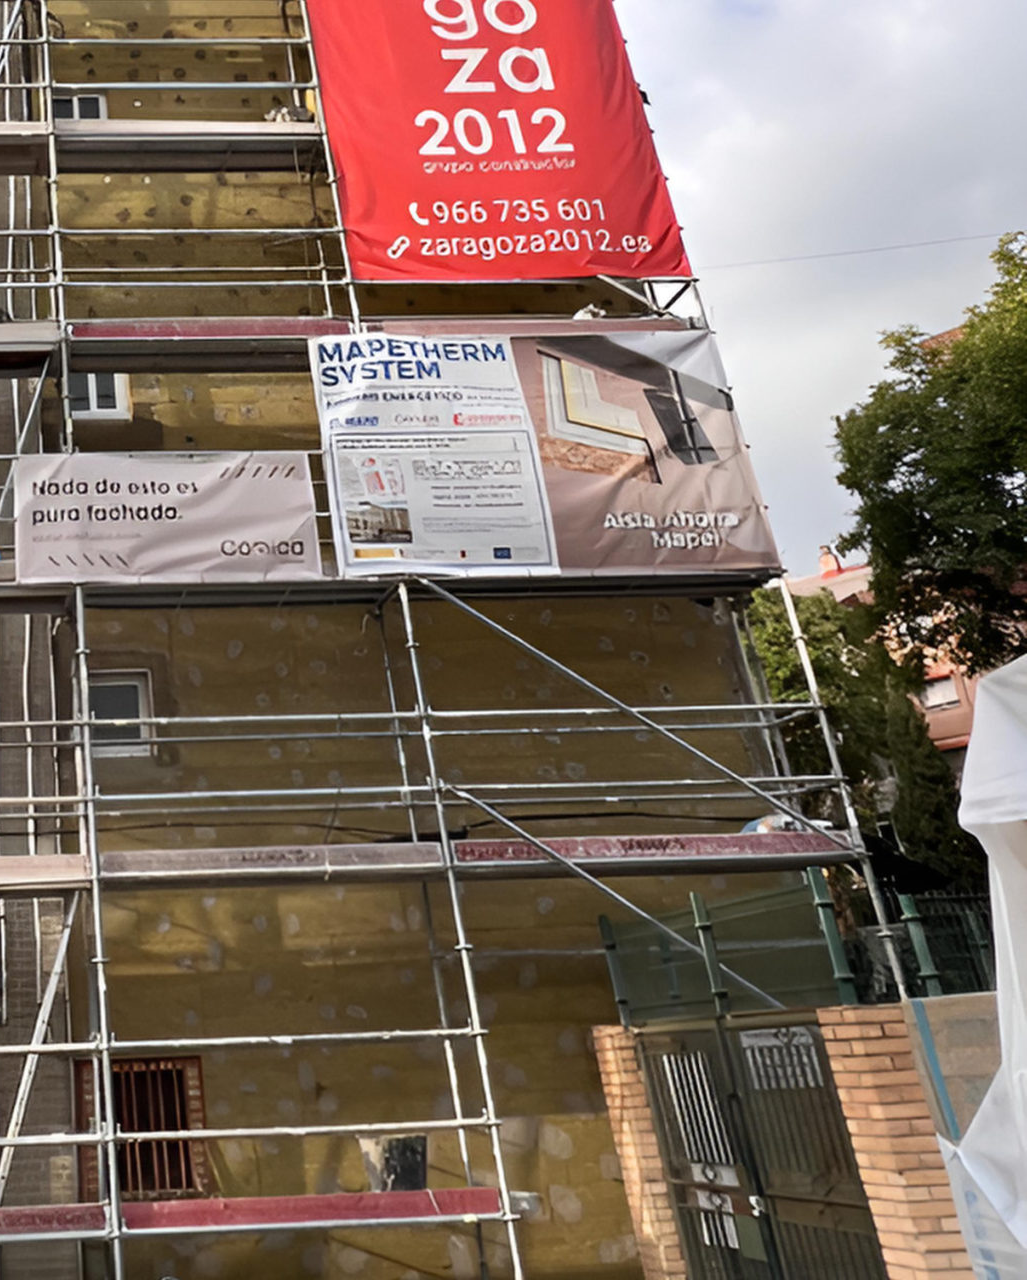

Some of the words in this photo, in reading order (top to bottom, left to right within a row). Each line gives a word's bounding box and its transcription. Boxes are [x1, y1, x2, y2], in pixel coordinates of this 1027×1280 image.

[441, 46, 555, 94] za
[414, 107, 574, 156] 2012
[432, 201, 488, 224] 966
[493, 198, 549, 222] 735
[557, 198, 605, 221] 601
[318, 338, 507, 364] MAPETHERM
[32, 478, 88, 496] Nada
[32, 507, 80, 526] pura
